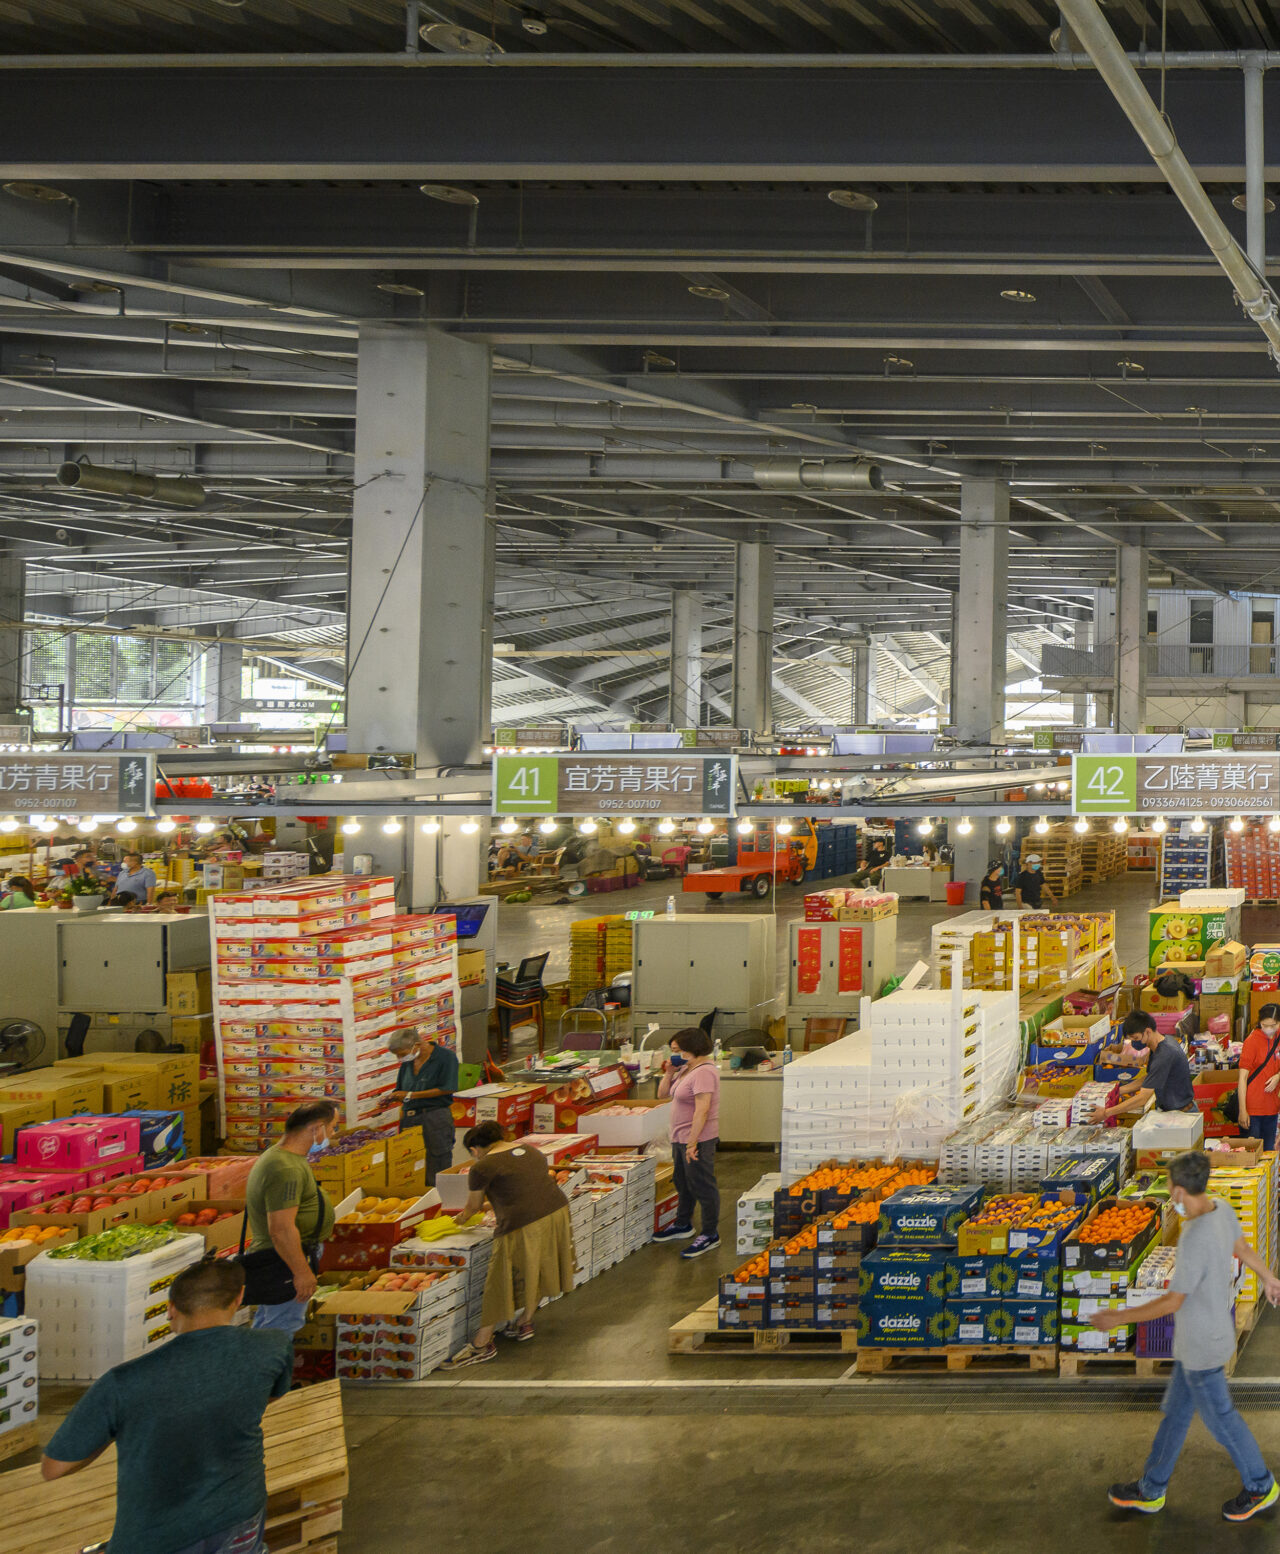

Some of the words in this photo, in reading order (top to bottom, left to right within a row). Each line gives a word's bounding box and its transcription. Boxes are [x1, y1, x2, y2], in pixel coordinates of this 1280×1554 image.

[1037, 733, 1049, 744] 86
[1217, 736, 1228, 746] 87
[0, 764, 112, 790] 芳青果行
[508, 768, 539, 796] 41
[565, 765, 697, 792] 宜芳青果行
[1088, 766, 1124, 795] 42
[1144, 764, 1273, 790] 乙陸菁菓行
[15, 799, 76, 808] 0952-007107
[600, 800, 661, 809] 0952-007107
[1142, 798, 1201, 808] 0933674125
[1211, 798, 1273, 807] 0930662561
[897, 1216, 937, 1227] dazzle
[880, 1272, 920, 1286] dazzle
[879, 1316, 921, 1328] dazzle
